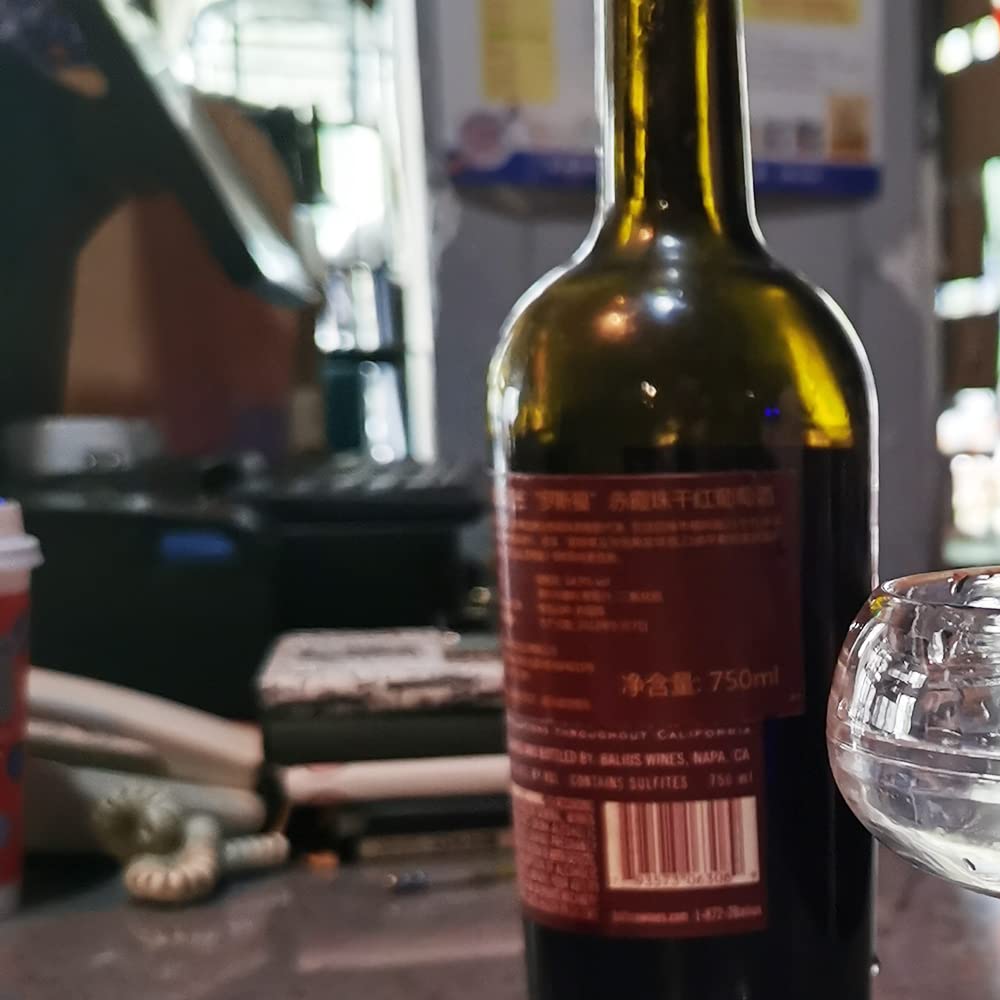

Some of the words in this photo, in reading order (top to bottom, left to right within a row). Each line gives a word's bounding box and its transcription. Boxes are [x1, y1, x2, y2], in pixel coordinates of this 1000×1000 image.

[709, 665, 779, 692] 750ml
[733, 746, 750, 762] CA
[628, 775, 688, 791] SULFITES
